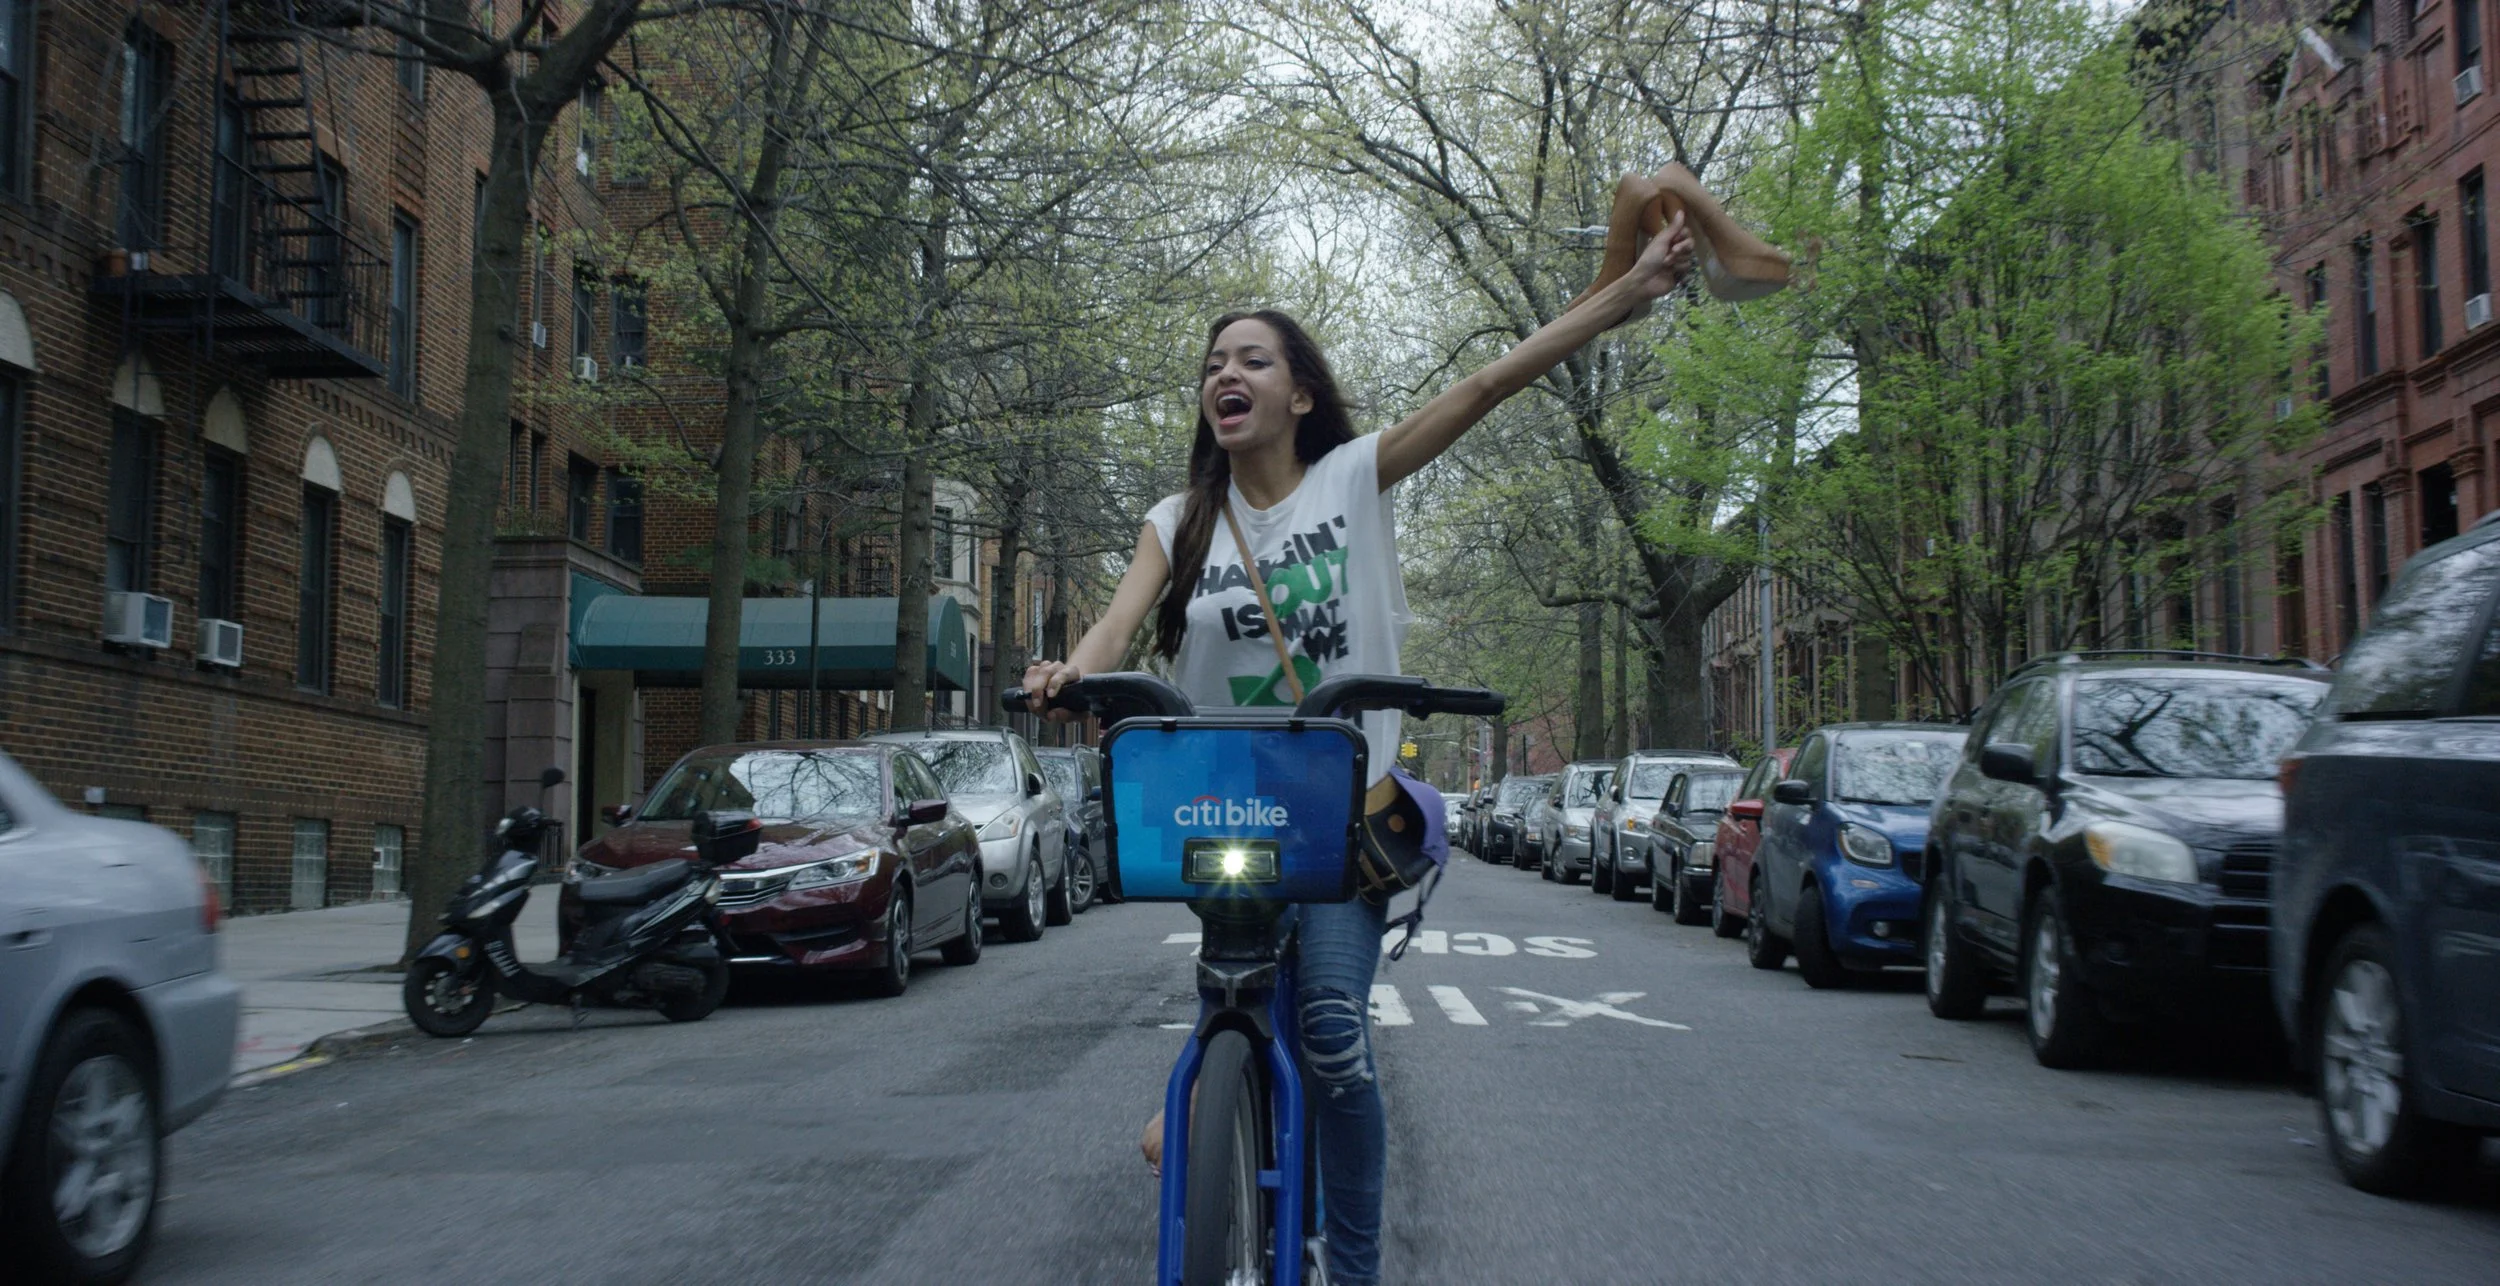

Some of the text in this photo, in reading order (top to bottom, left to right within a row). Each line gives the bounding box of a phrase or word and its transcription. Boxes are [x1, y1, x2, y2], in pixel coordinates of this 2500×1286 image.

[1267, 546, 1348, 617] OUT
[1221, 604, 1271, 641] IS
[763, 650, 796, 665] 333
[1302, 620, 1349, 664] WE
[1174, 796, 1289, 827] citi bike
